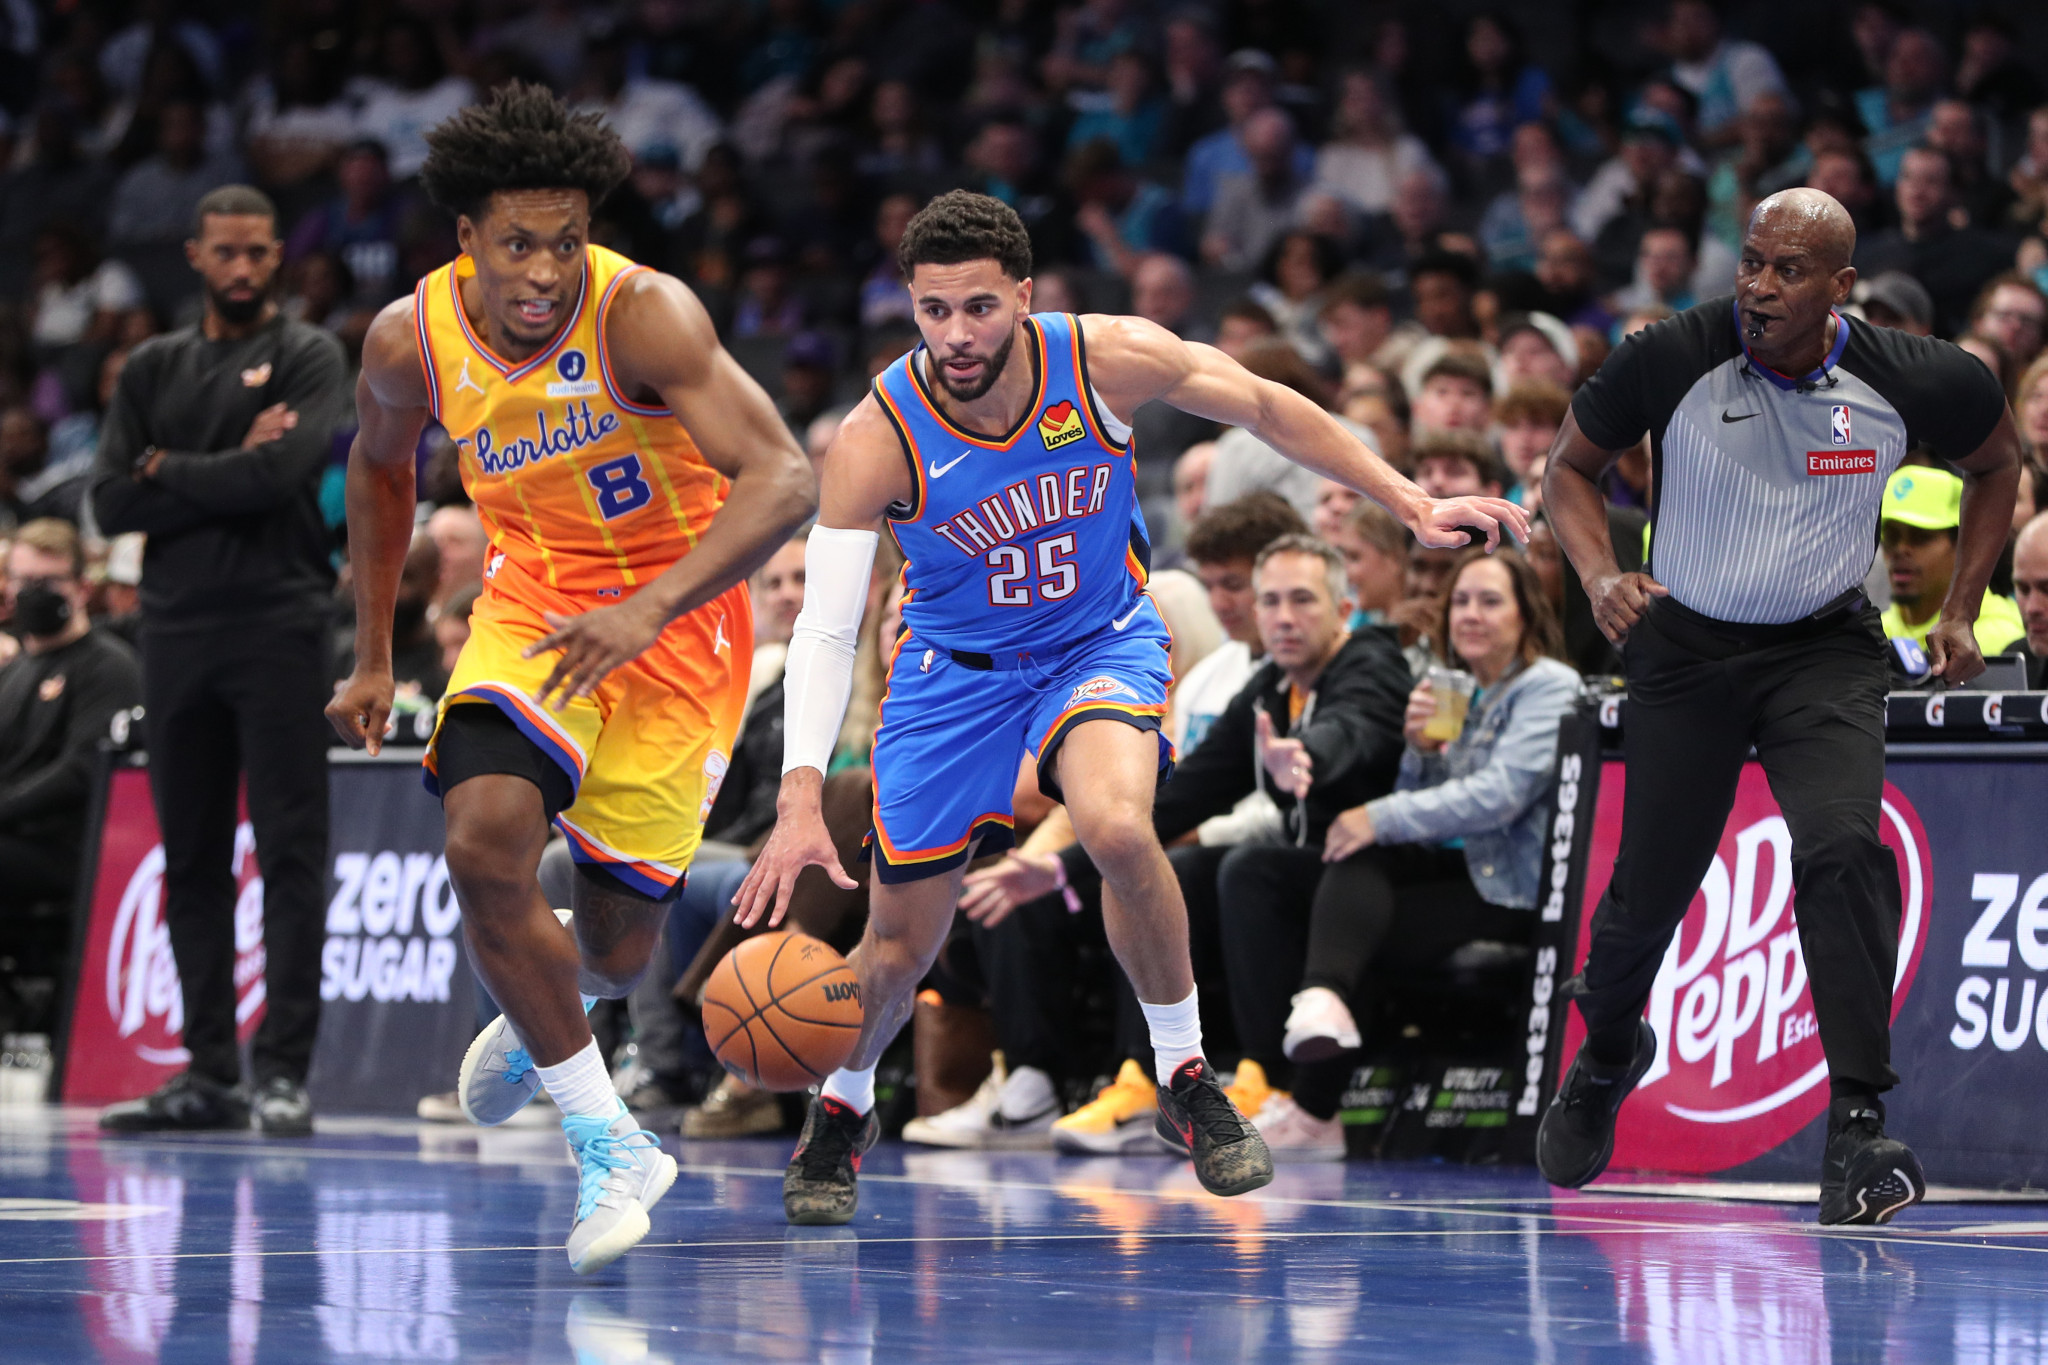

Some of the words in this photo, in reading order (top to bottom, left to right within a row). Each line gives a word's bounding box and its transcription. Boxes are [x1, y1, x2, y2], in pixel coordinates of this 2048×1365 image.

[456, 400, 620, 475] harlotte
[1809, 456, 1874, 470] Emirates
[586, 453, 652, 521] 8
[931, 463, 1112, 559] THUNDER
[985, 531, 1079, 607] 25
[1925, 694, 1946, 727] G
[1983, 694, 2004, 726] G
[1541, 753, 1582, 921] bet365
[325, 851, 461, 937] zero
[320, 935, 457, 1002] SUGAR
[1516, 946, 1557, 1115] bet365
